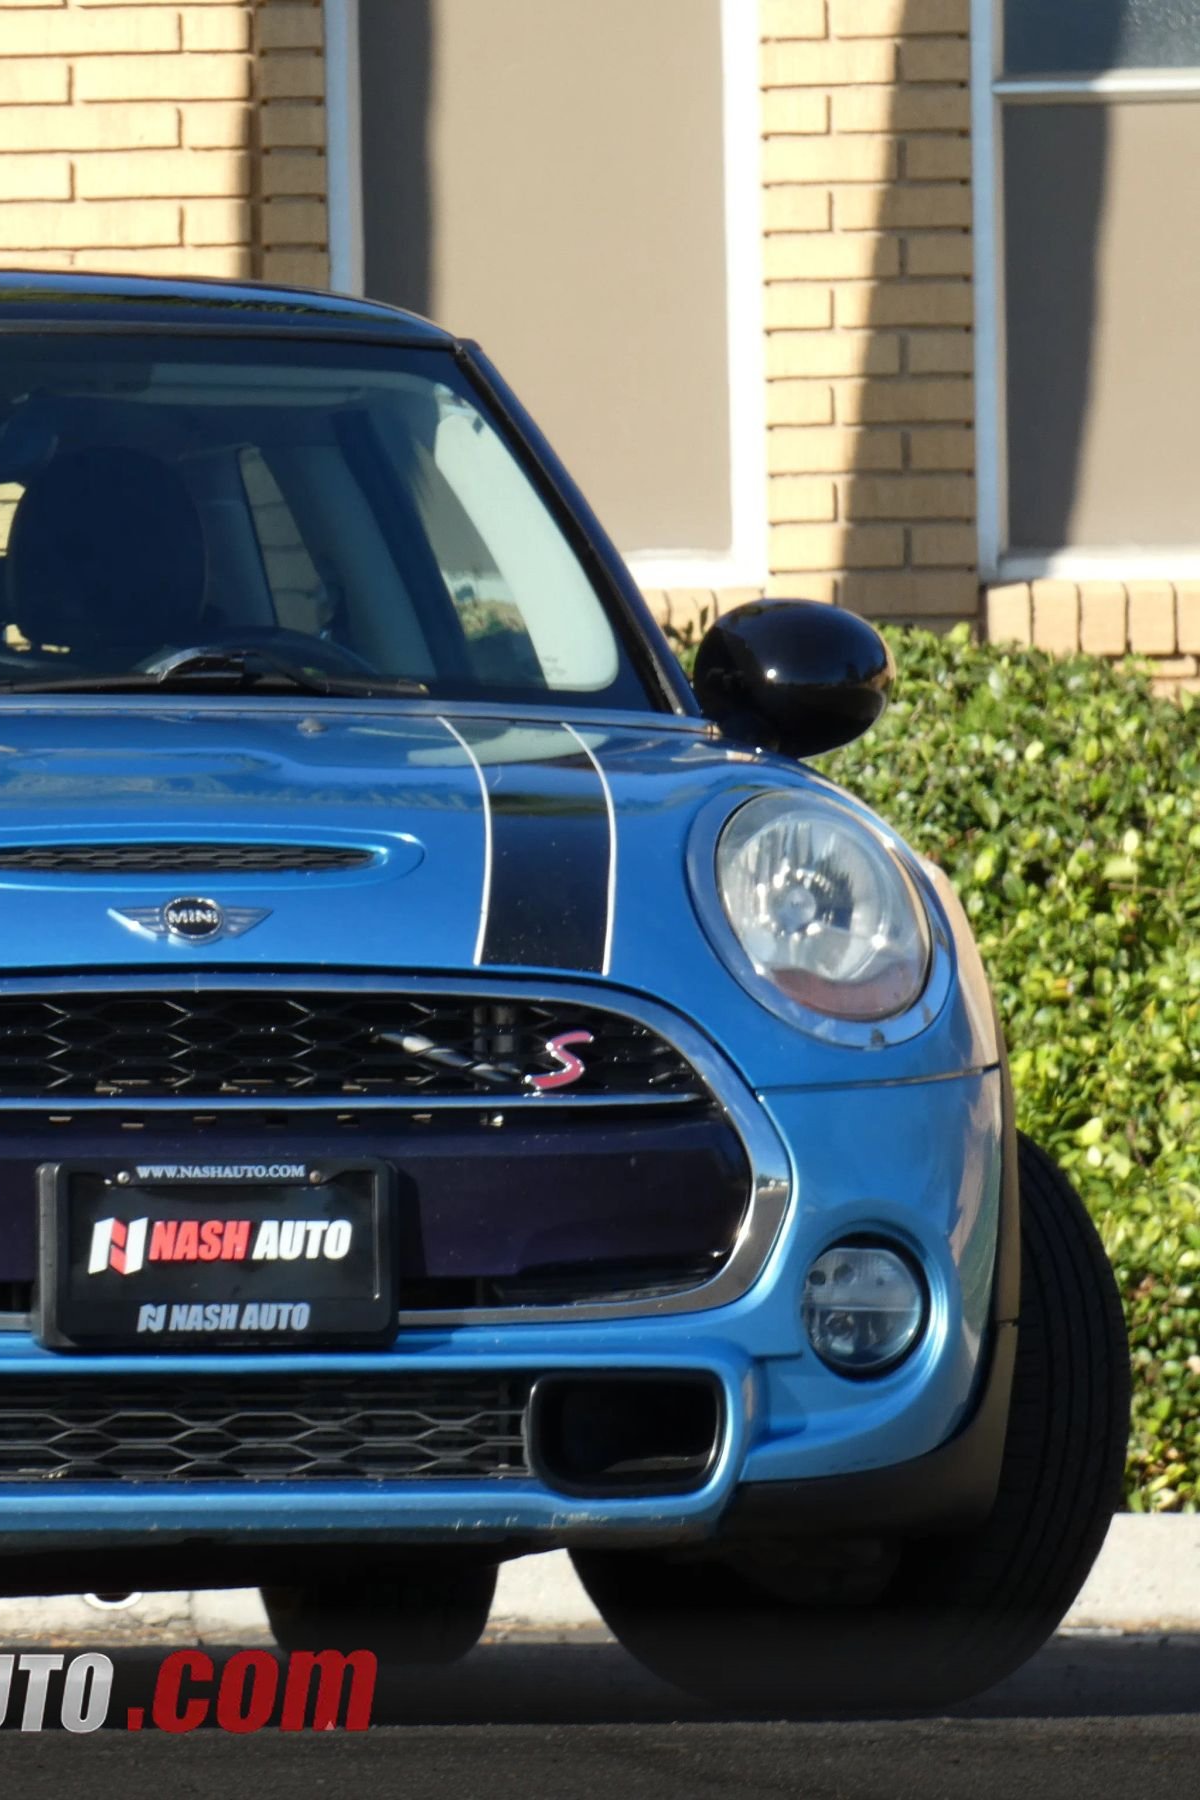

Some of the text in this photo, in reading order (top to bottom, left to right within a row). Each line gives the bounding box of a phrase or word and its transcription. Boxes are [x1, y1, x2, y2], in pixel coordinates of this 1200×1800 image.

[168, 910, 219, 923] MINI
[523, 1030, 594, 1090] S
[136, 1165, 305, 1179] WWW.NASHAUTO.COM
[148, 1220, 251, 1261] NASH
[252, 1220, 353, 1260] AUTO
[169, 1304, 243, 1331] NASH
[240, 1304, 311, 1331] AUTO
